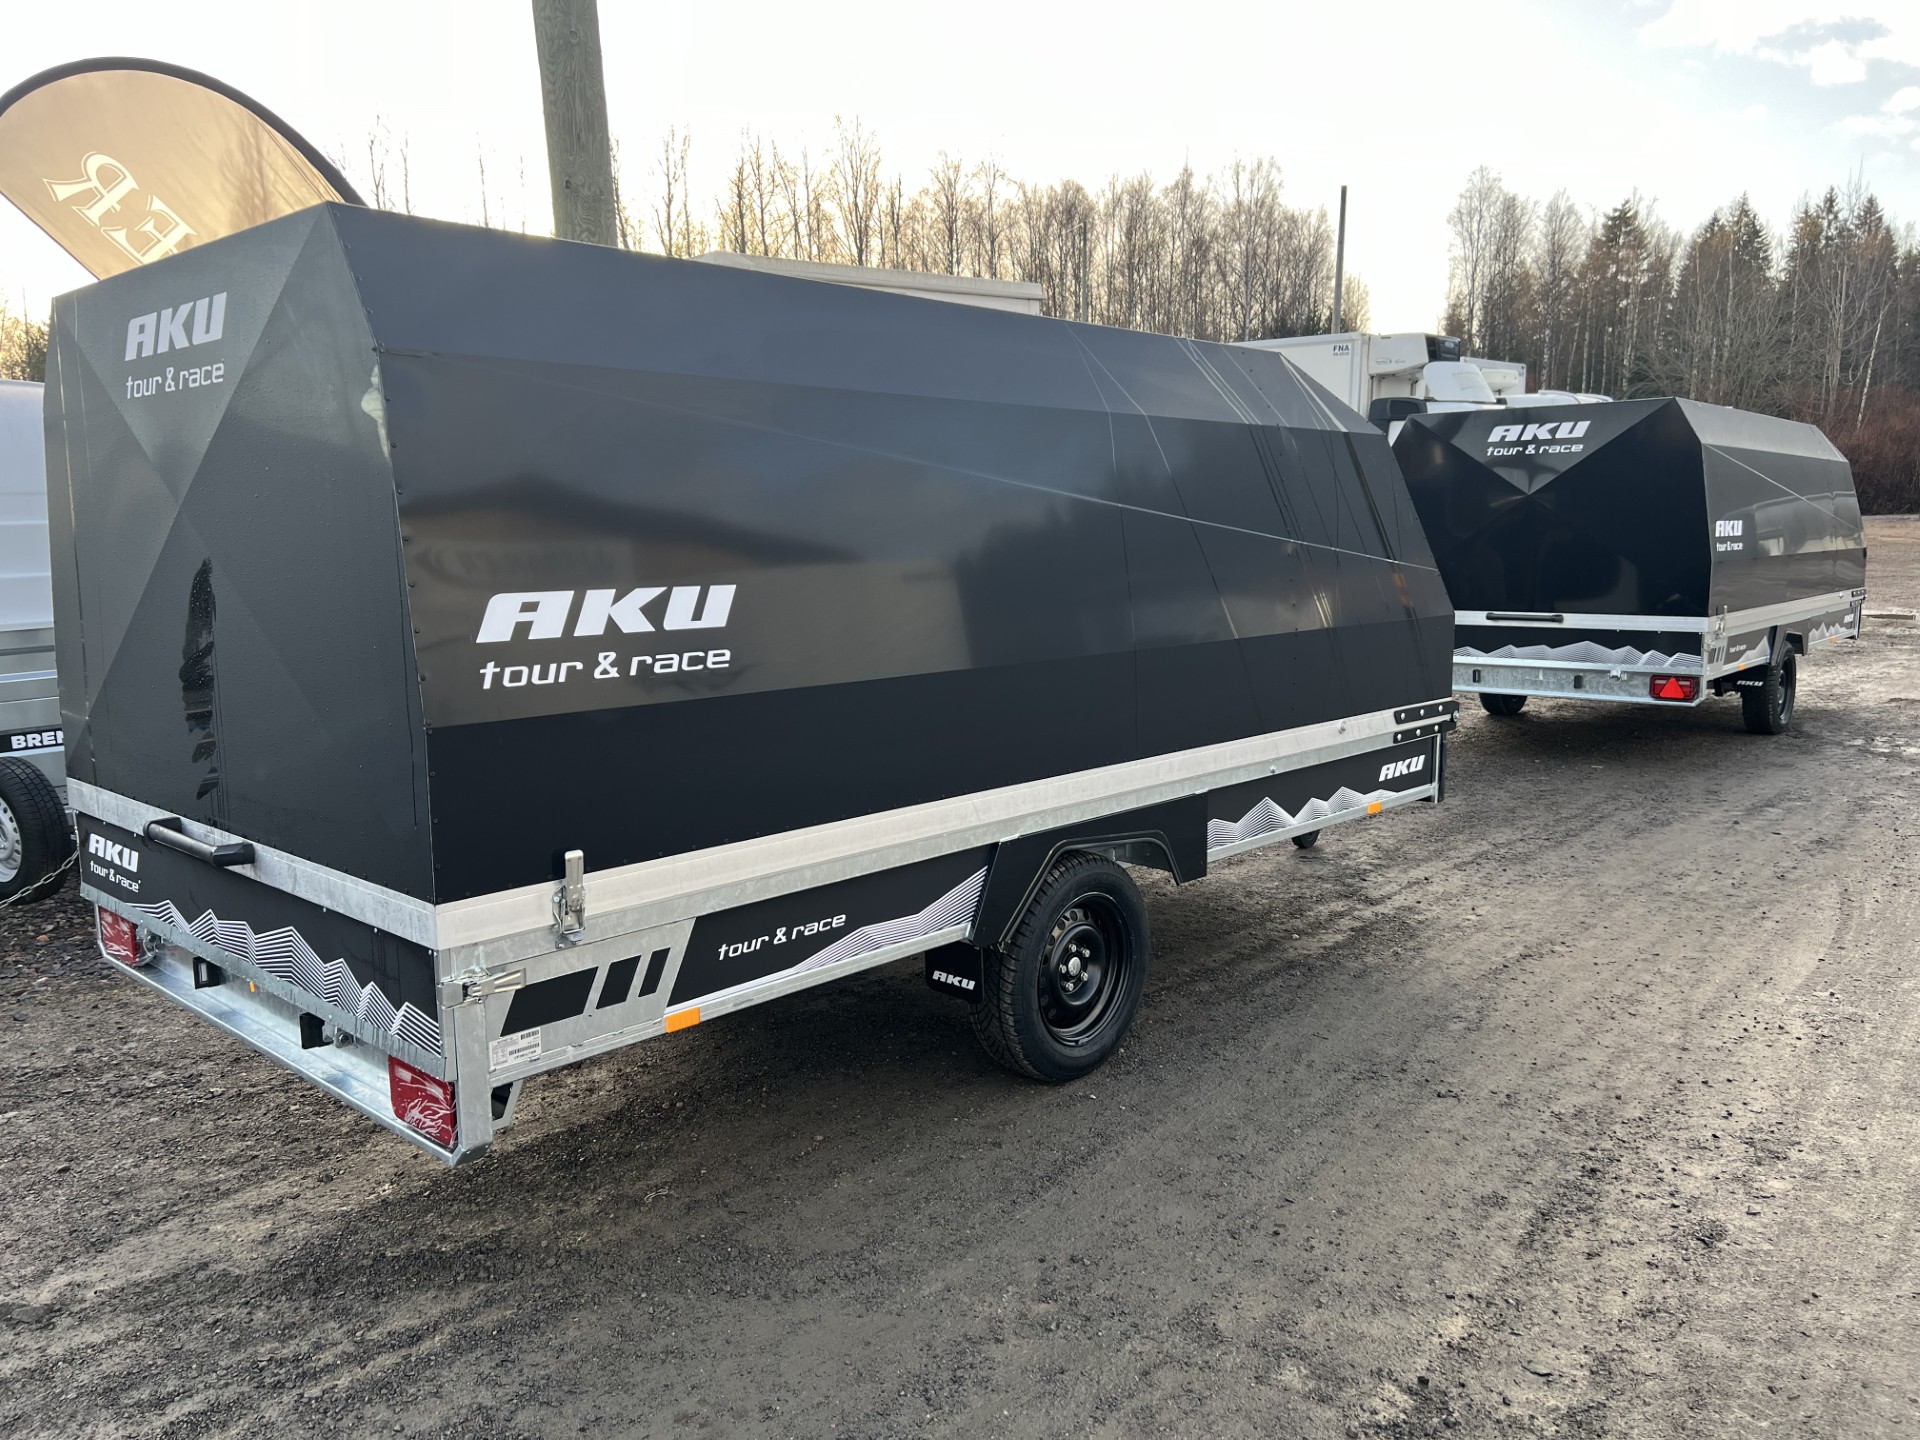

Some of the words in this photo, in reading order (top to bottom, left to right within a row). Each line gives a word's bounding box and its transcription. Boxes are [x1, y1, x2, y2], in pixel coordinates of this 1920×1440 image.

[125, 291, 227, 361] AKU
[1333, 344, 1349, 352] FNA
[126, 376, 162, 399] tour
[165, 367, 176, 392] &
[179, 363, 224, 390] race
[1487, 420, 1591, 442] AKU
[1487, 446, 1522, 456] tour
[1525, 444, 1535, 455] &
[1538, 443, 1584, 453] race
[1715, 520, 1743, 537] AKU
[475, 584, 737, 643] AKU
[479, 661, 583, 689] tour
[593, 652, 620, 679] &
[629, 649, 731, 676] race
[1379, 754, 1425, 782] AKU
[89, 833, 139, 873] AKU
[90, 860, 109, 878] tour
[109, 869, 116, 882] &
[116, 874, 139, 893] race
[718, 935, 769, 961] tour
[773, 927, 787, 945] &
[791, 913, 846, 940] race
[932, 970, 975, 991] AKU
